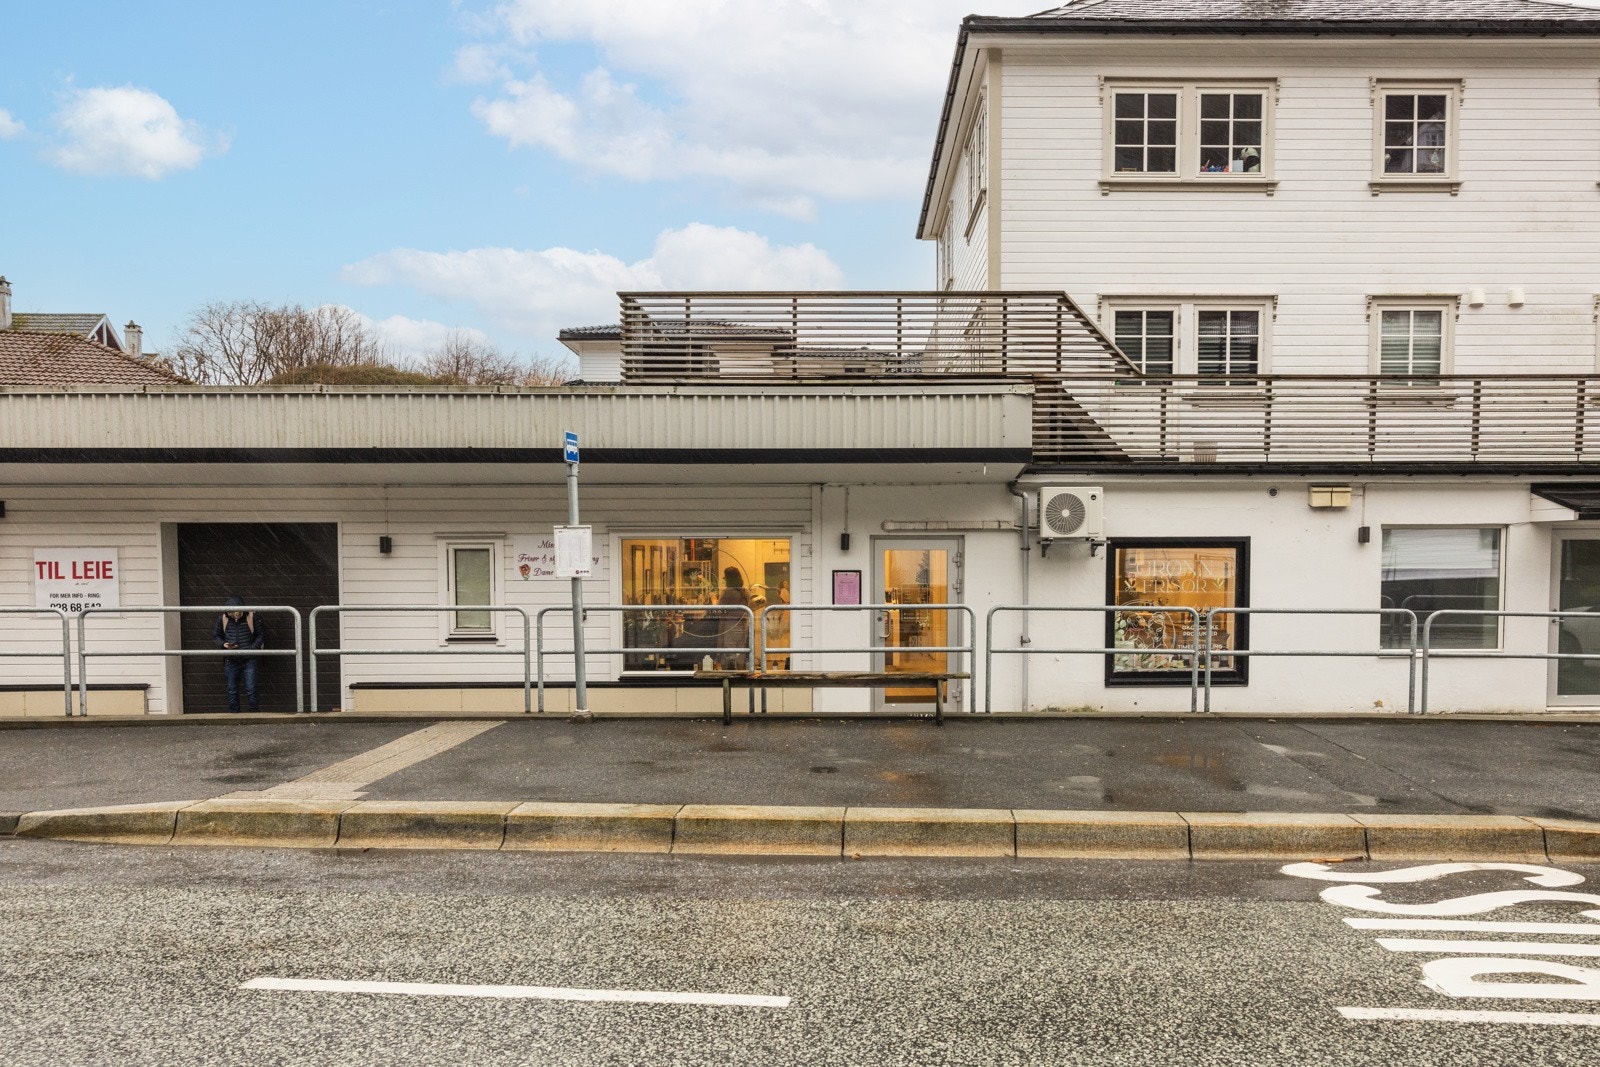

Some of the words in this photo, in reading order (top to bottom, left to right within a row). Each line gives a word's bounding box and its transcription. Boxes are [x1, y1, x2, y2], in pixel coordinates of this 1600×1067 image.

[35, 561, 66, 579] TIL
[72, 561, 114, 579] LEIE
[1136, 560, 1214, 577] GRØNN
[1143, 579, 1208, 594] FRISØR
[70, 603, 82, 612] 68
